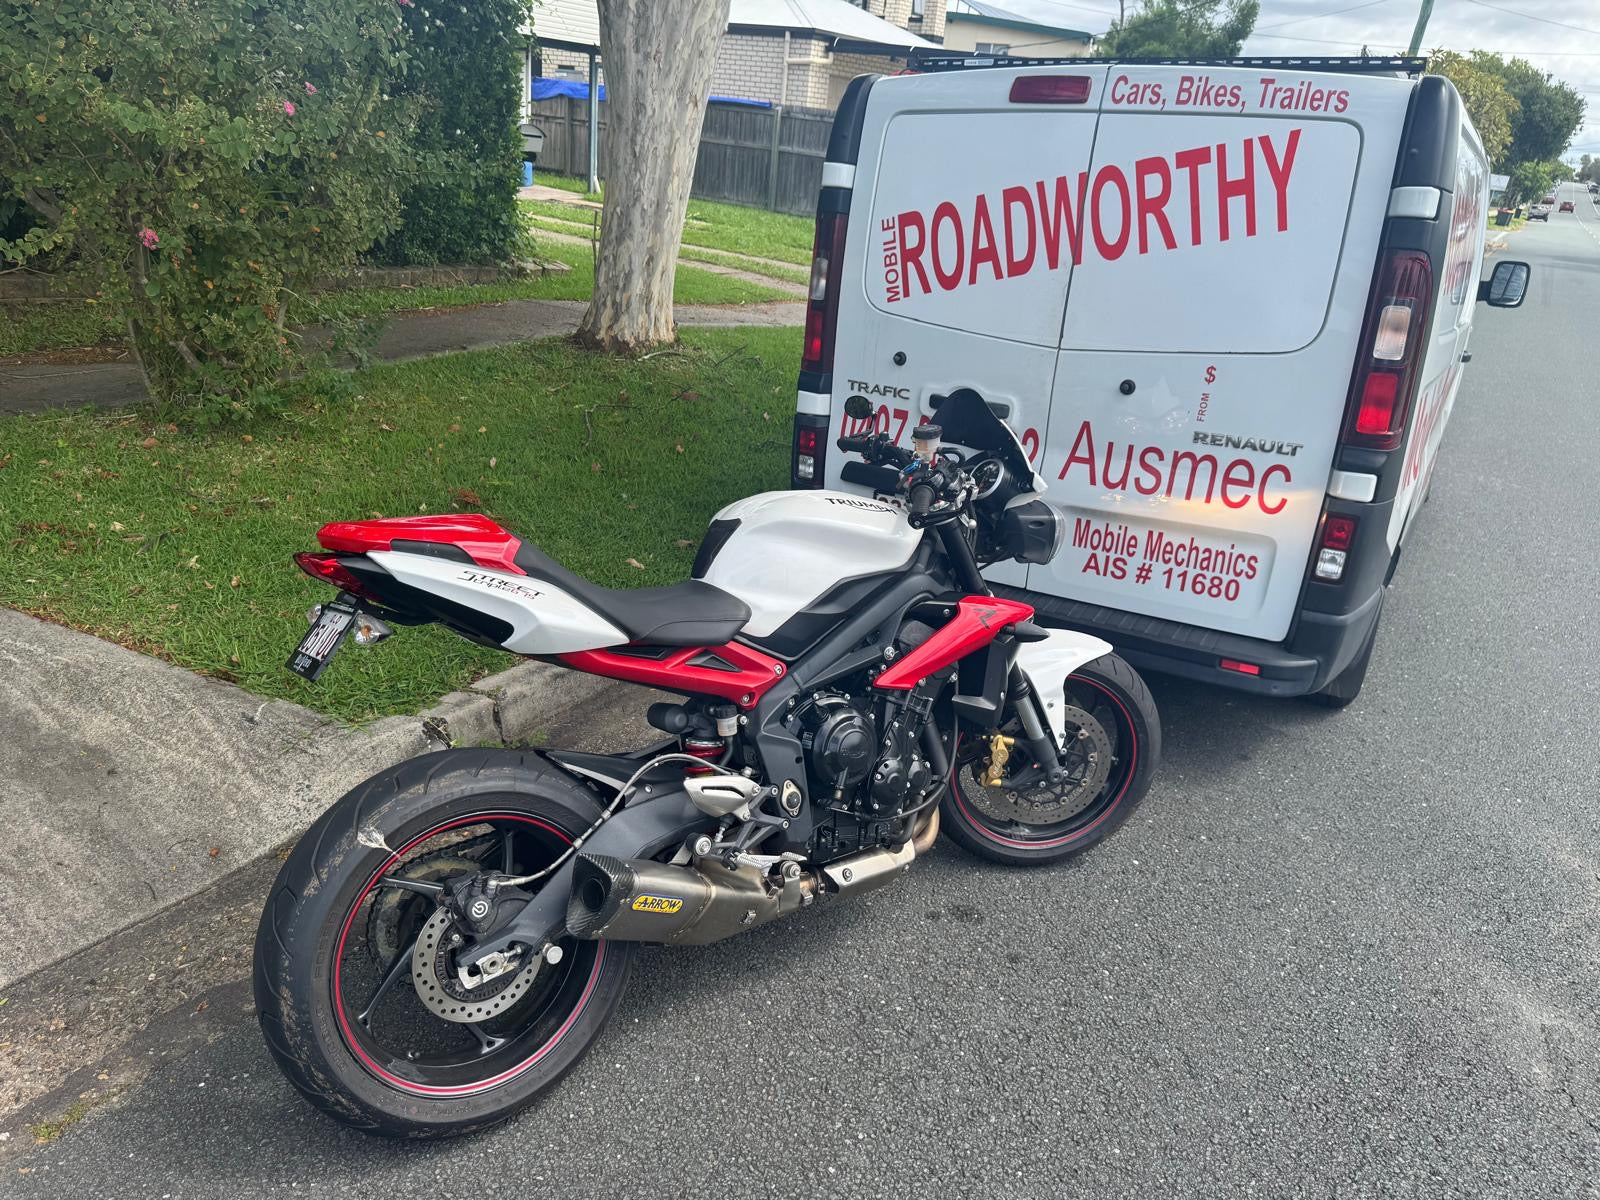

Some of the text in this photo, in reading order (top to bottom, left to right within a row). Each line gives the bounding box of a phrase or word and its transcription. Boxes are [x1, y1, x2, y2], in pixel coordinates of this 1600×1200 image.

[1111, 74, 1350, 114] Cars, Bikes, Trailers
[897, 128, 1302, 298] ROADWORTHY
[881, 216, 901, 303] MOBILE
[847, 378, 911, 400] TRAFIC
[1196, 392, 1211, 423] FROM
[1192, 430, 1304, 457] RENAULT
[1058, 421, 1292, 517] Ausmec
[824, 497, 898, 516] TRIUMPH
[1072, 516, 1260, 580] Mobile Mechanics
[456, 569, 547, 597] STREET
[1081, 552, 1241, 601] AIS # 11680
[638, 896, 682, 910] ARROW
